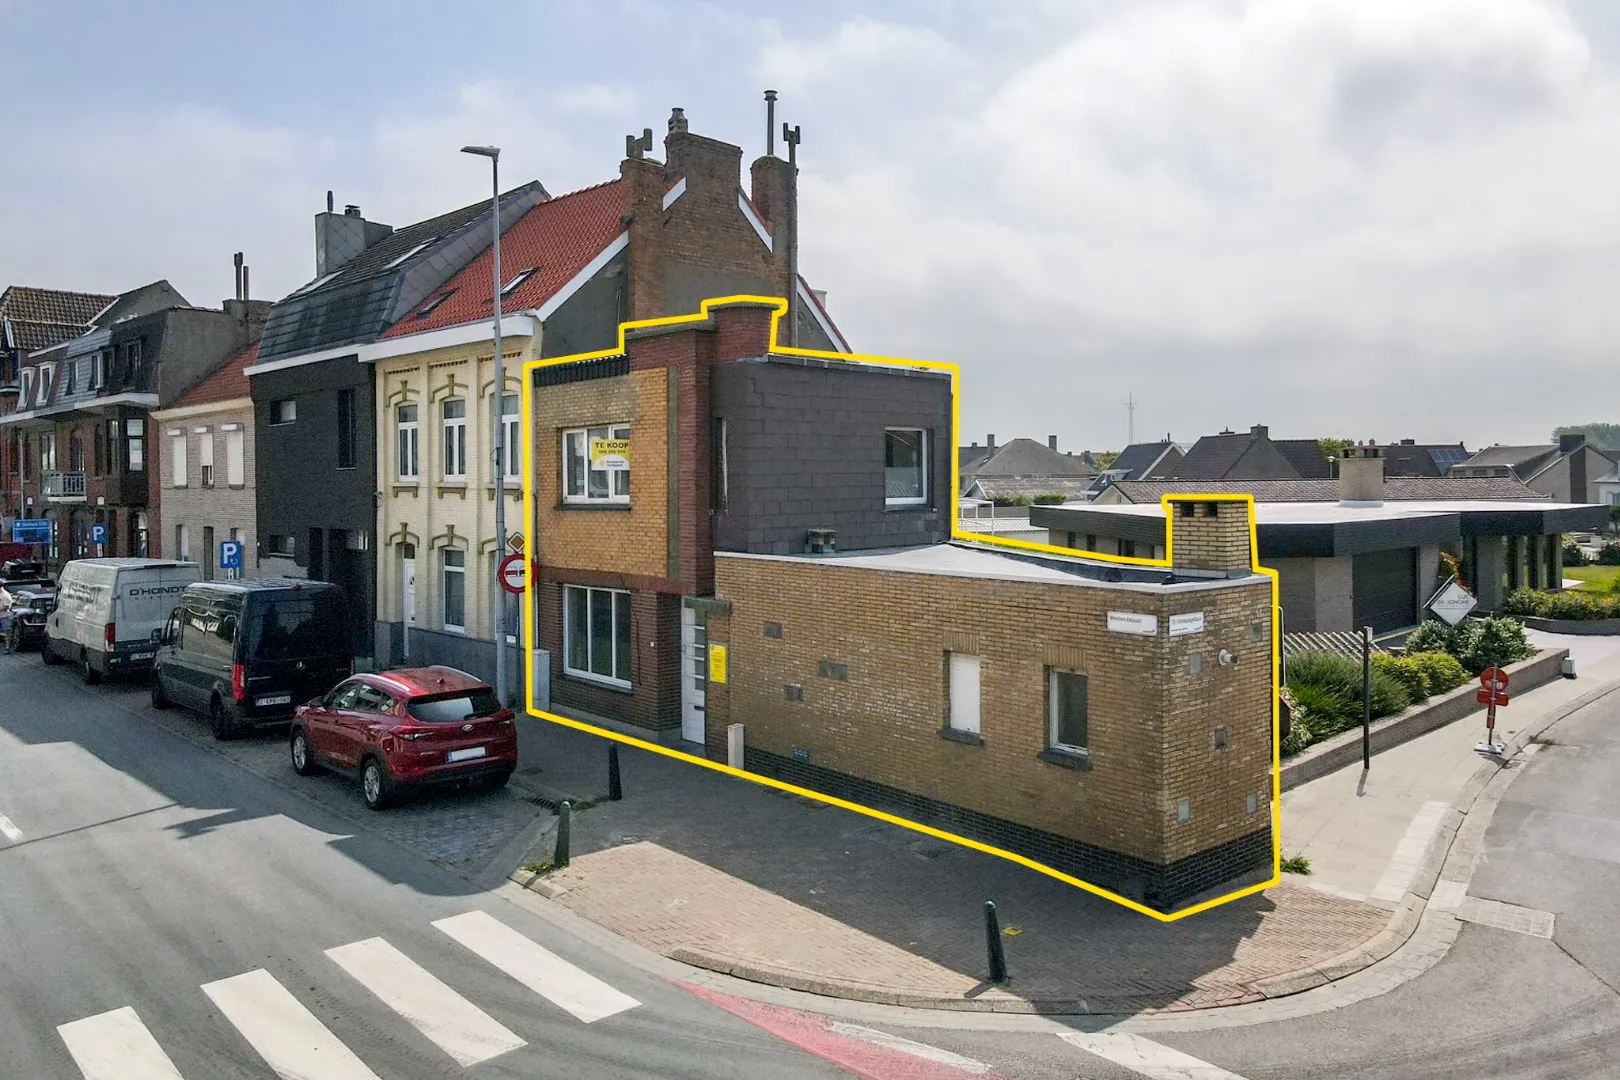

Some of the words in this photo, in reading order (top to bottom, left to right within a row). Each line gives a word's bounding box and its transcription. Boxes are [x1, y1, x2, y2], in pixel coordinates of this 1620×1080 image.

[92, 526, 105, 541] P
[223, 543, 237, 565] P
[129, 586, 187, 596] D'HONDT
